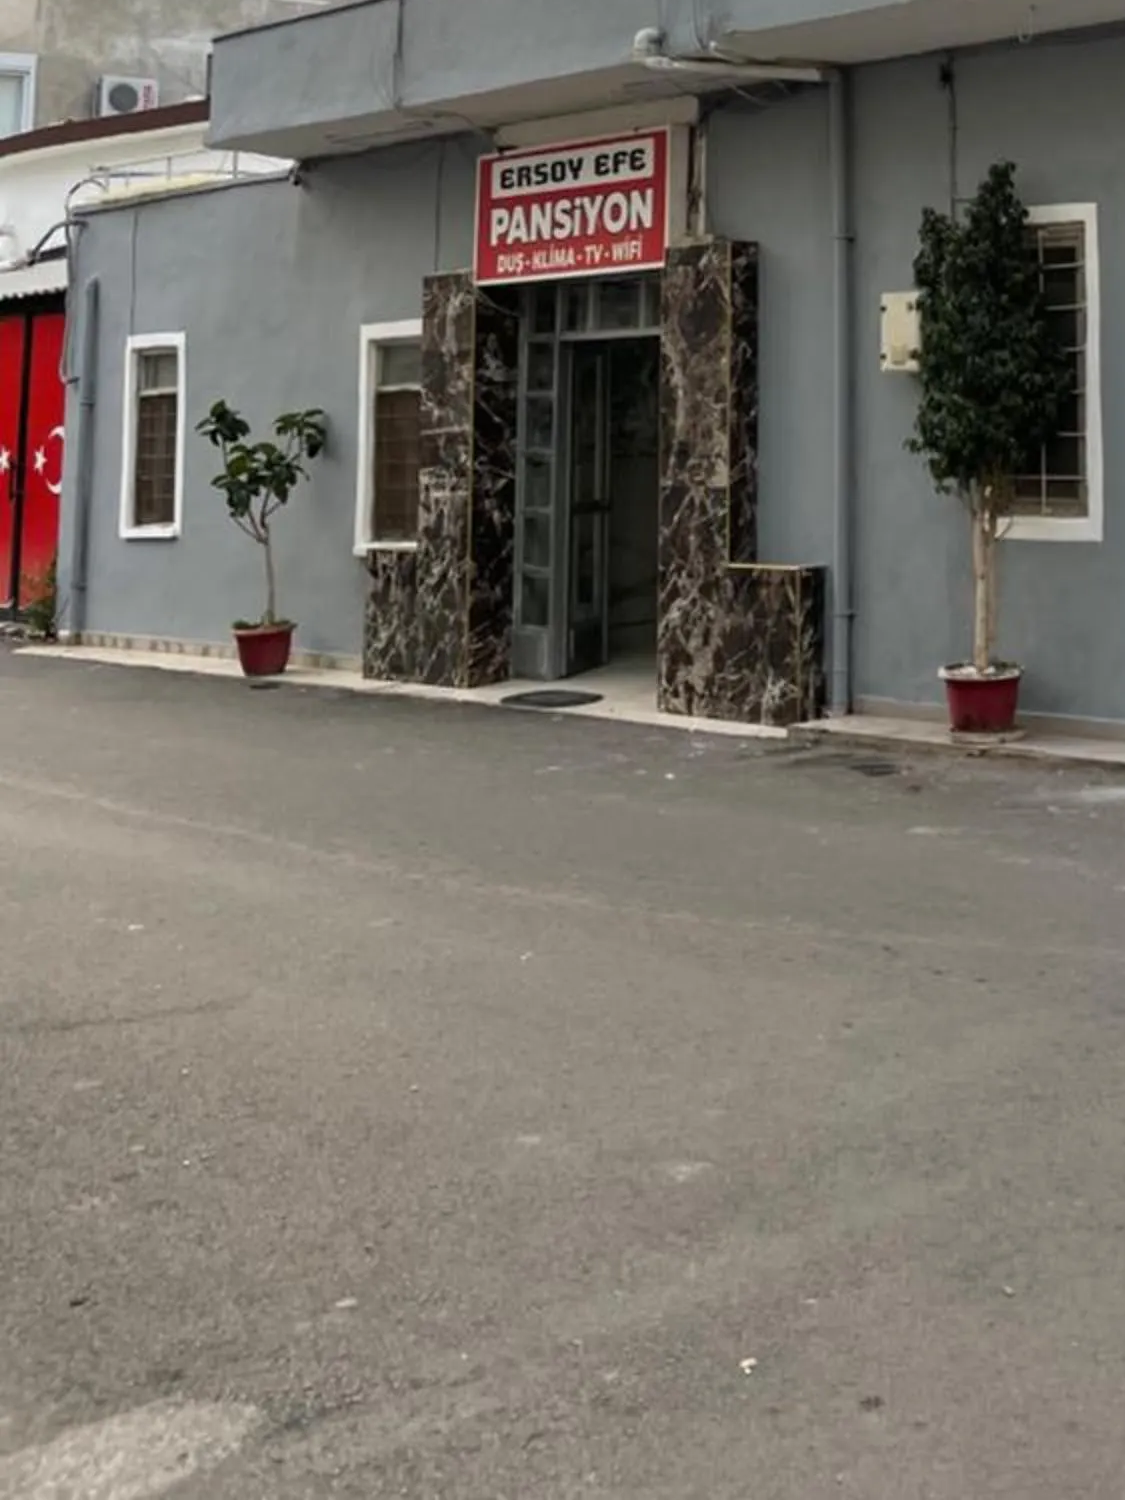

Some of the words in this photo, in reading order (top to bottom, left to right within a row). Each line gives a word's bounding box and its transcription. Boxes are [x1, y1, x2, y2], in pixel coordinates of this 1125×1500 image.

[500, 157, 584, 190] ERSOY
[594, 148, 647, 177] EFE
[583, 244, 603, 264] TV
